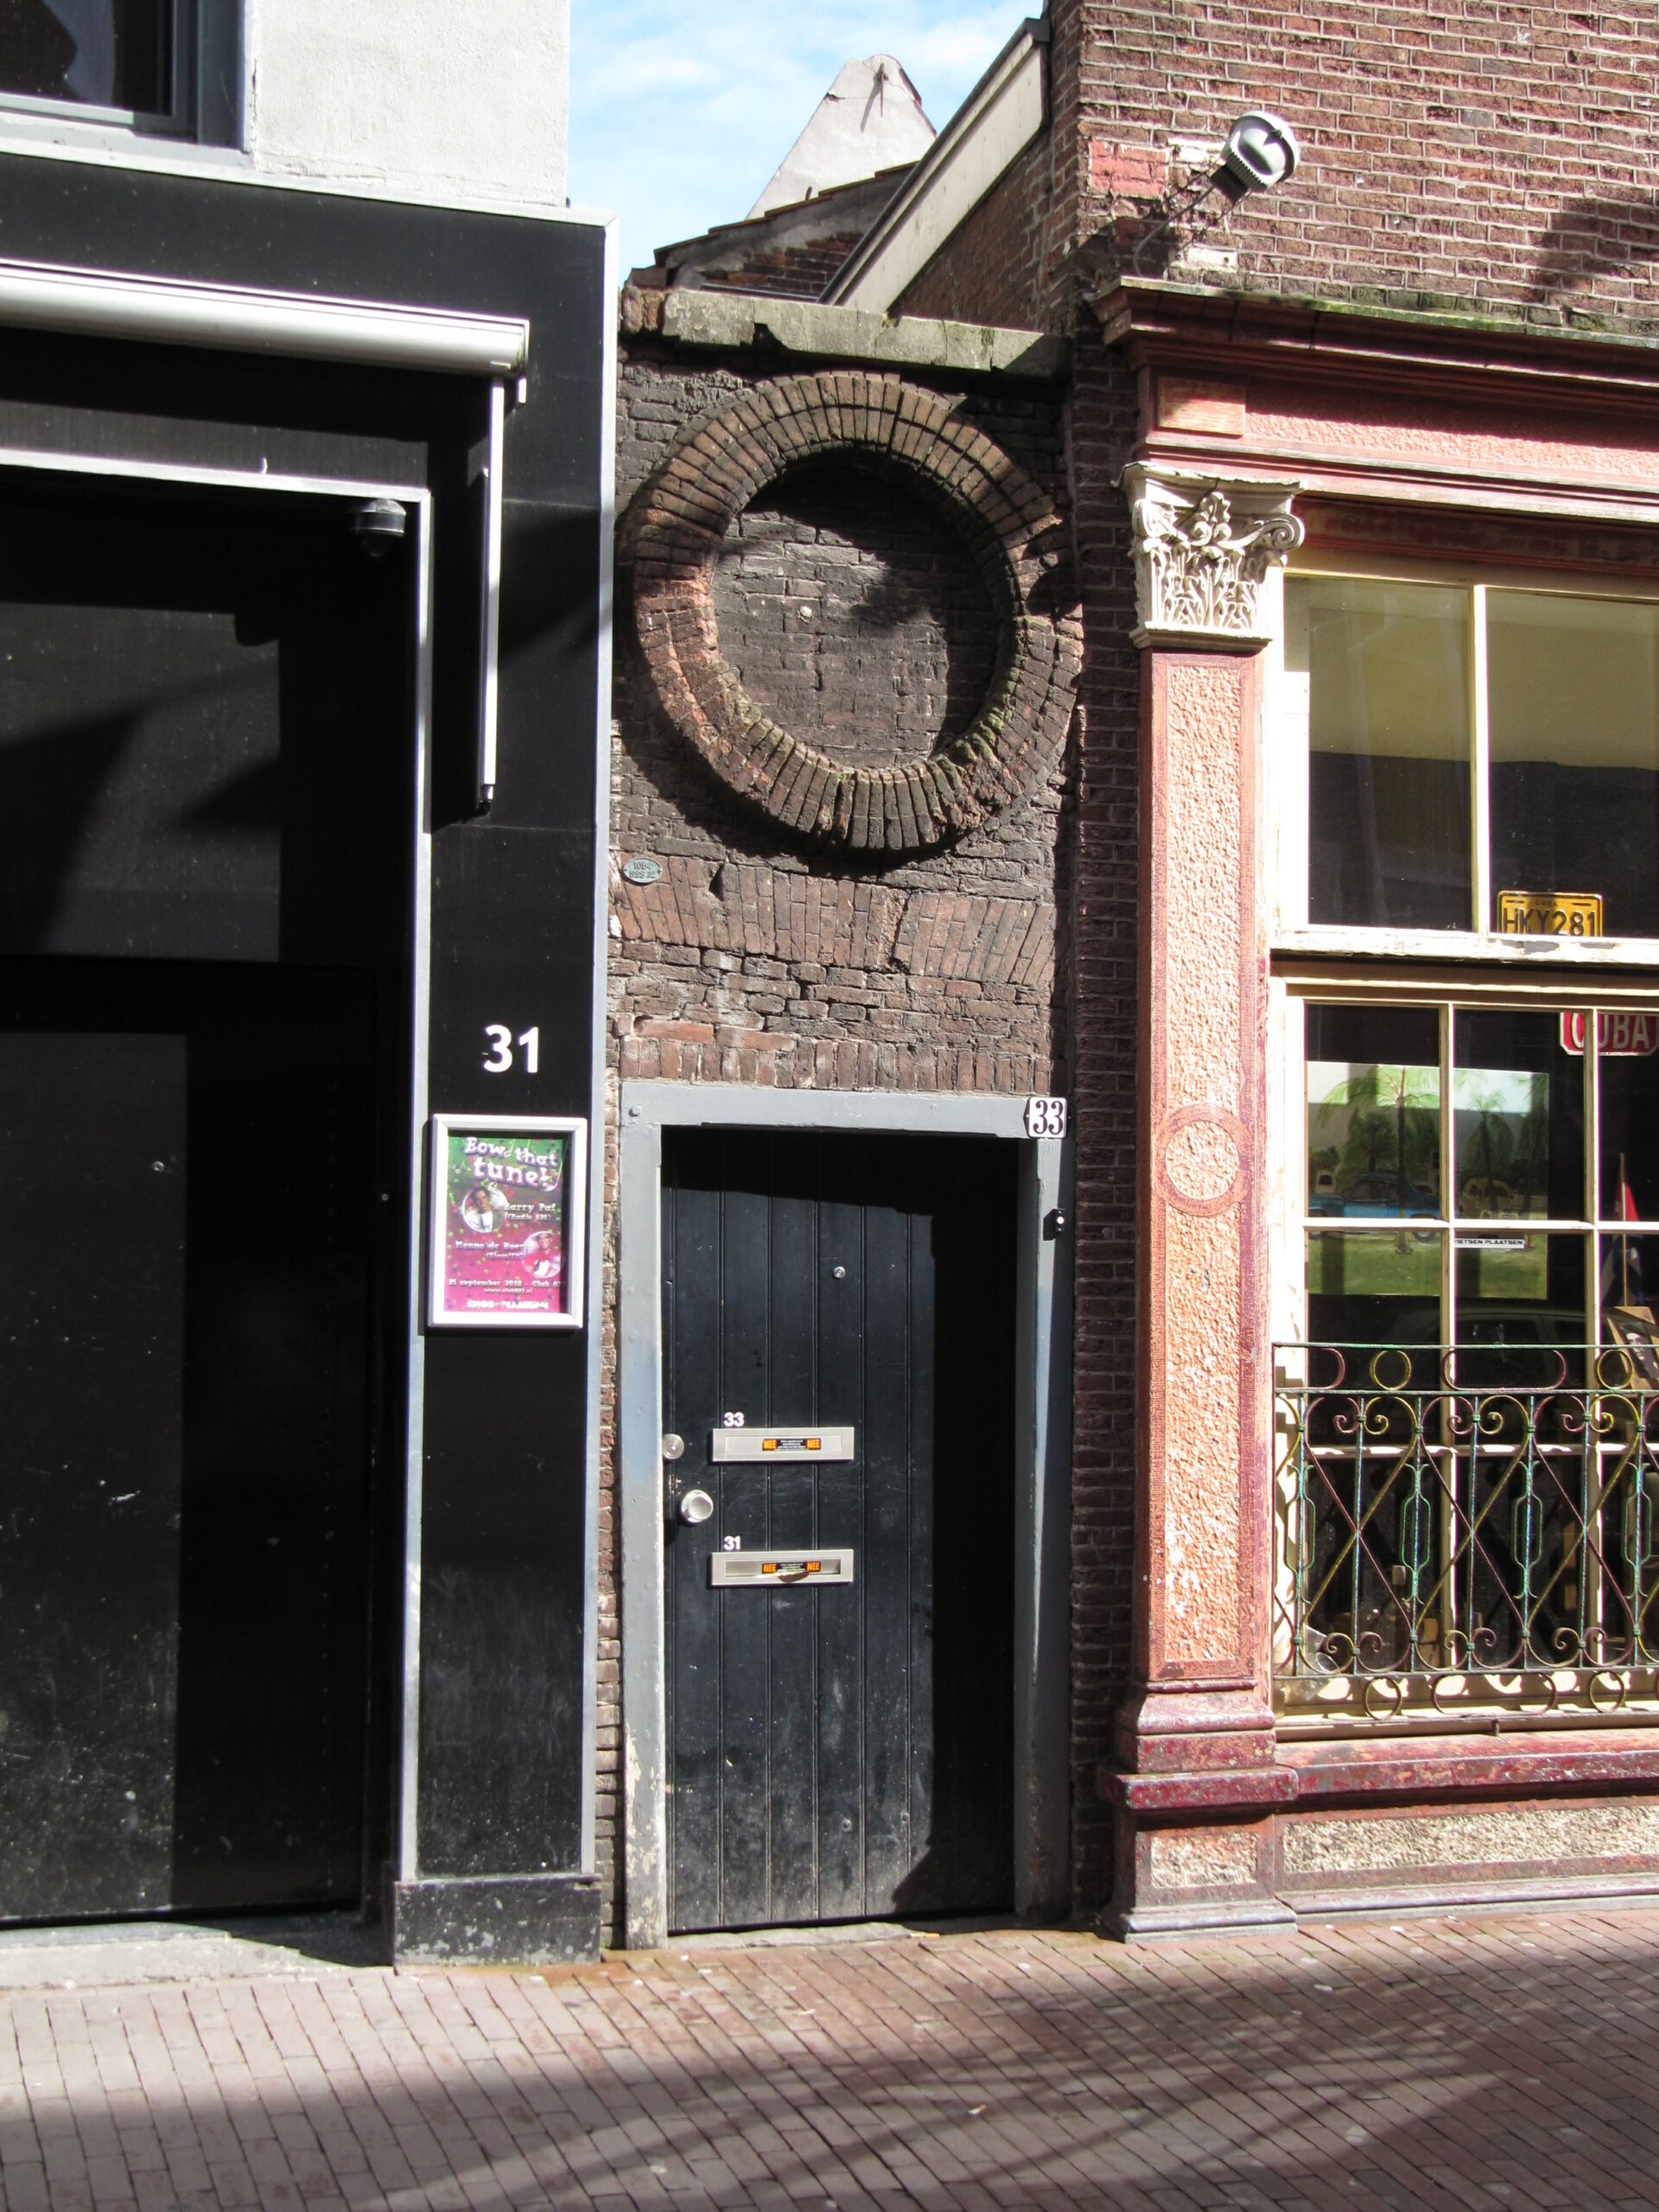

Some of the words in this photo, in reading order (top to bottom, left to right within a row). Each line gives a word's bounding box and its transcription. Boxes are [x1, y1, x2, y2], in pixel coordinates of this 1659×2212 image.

[1503, 907, 1596, 936] HKY281
[484, 1024, 539, 1073] 31
[1033, 1099, 1064, 1135] 33
[515, 1147, 558, 1166] that
[460, 1279, 501, 1287] september
[724, 1412, 745, 1427] 33
[763, 1439, 777, 1450] NEE
[806, 1438, 820, 1449] NEE
[723, 1535, 741, 1550] 31
[763, 1563, 777, 1573] NEE
[806, 1561, 820, 1571] NEE
